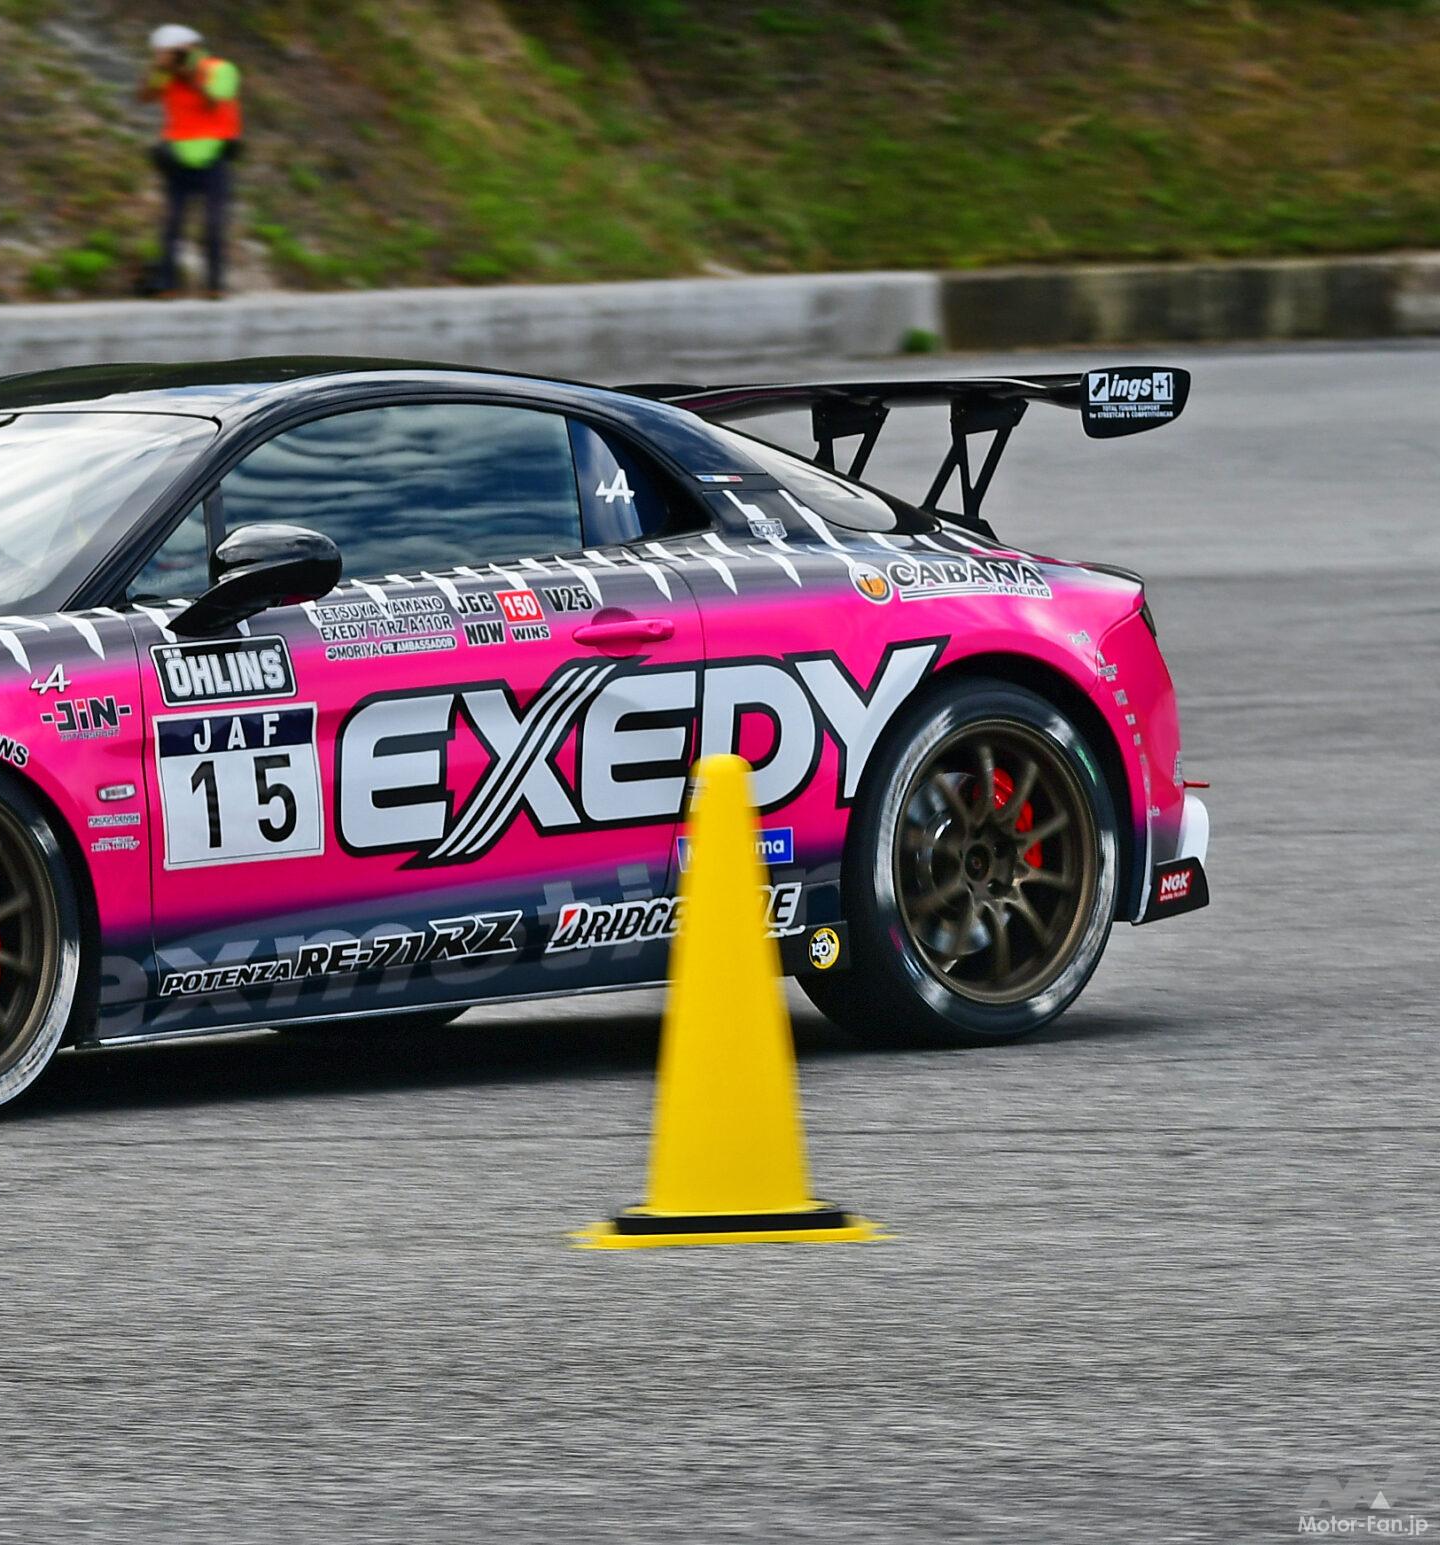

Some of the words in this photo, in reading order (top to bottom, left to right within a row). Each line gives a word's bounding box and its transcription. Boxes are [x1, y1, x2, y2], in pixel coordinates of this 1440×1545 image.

[1110, 373, 1152, 401] ings
[889, 562, 1045, 588] CABANA
[312, 603, 380, 621] TETSUYA
[381, 597, 443, 616] YAMANO
[504, 595, 537, 617] 150
[544, 586, 593, 612] V25
[320, 624, 366, 642] EXEDY
[370, 619, 407, 637] 71RZ
[411, 615, 453, 633] A110R
[464, 622, 505, 645] NOW
[512, 625, 550, 641] WINS
[337, 644, 379, 659] MORIYA
[398, 637, 453, 651] AMBASSADOR
[162, 648, 287, 697] ÖHLINS
[194, 713, 280, 752] JAF
[340, 643, 939, 860] EXEDY
[191, 753, 297, 849] 15
[1161, 871, 1190, 894] NGK
[161, 959, 292, 996] POTENZA
